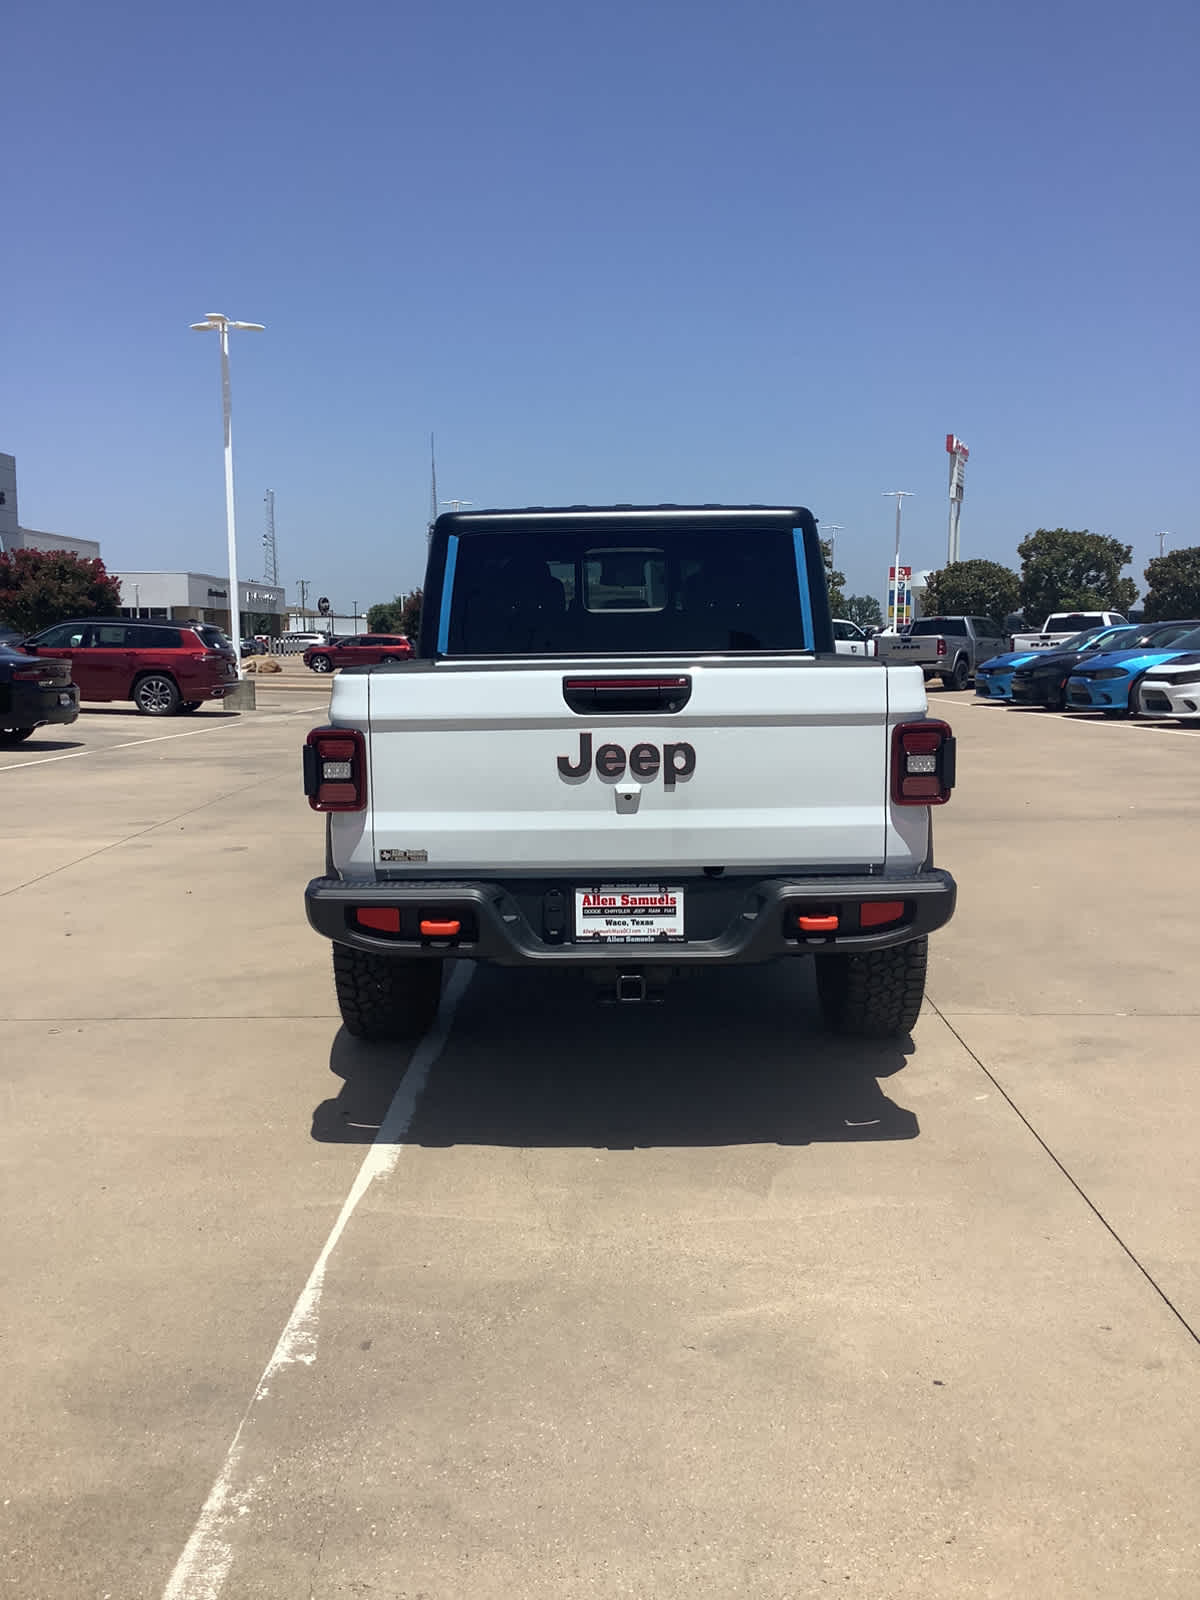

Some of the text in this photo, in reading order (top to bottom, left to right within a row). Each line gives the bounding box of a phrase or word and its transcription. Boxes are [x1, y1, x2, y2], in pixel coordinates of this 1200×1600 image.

[557, 732, 696, 786] Jeep
[582, 893, 677, 906] Allen Samuels
[605, 919, 629, 927] Waco,
